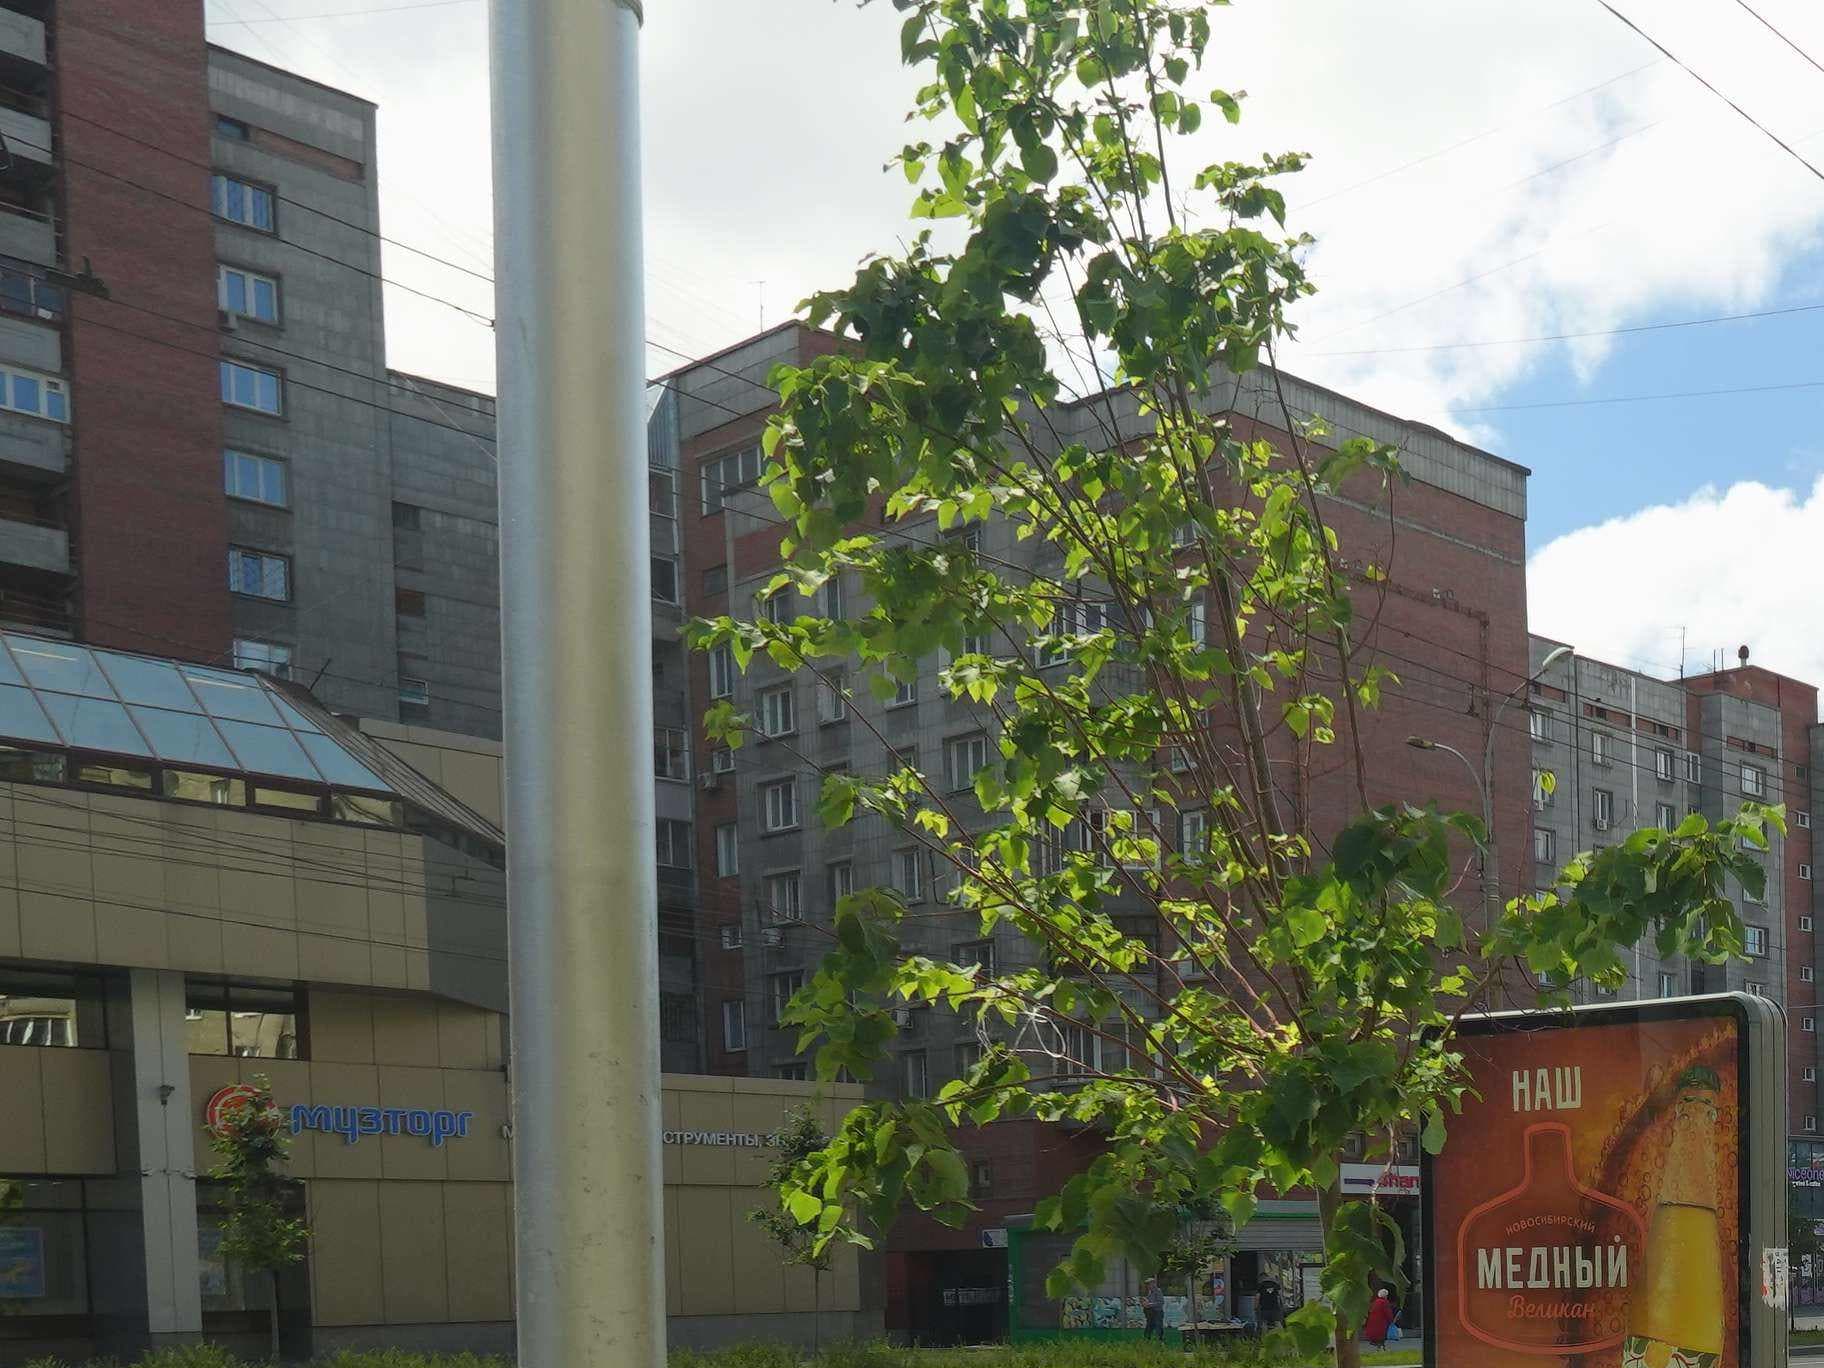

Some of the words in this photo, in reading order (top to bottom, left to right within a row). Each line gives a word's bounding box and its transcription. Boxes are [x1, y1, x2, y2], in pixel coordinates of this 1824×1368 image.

[1512, 1066, 1582, 1112] НАШ
[663, 1131, 763, 1148] СТРУМЕНТЫ,
[1477, 1235, 1628, 1289] МЕДНЫЙ
[1507, 1295, 1597, 1319] Великан
